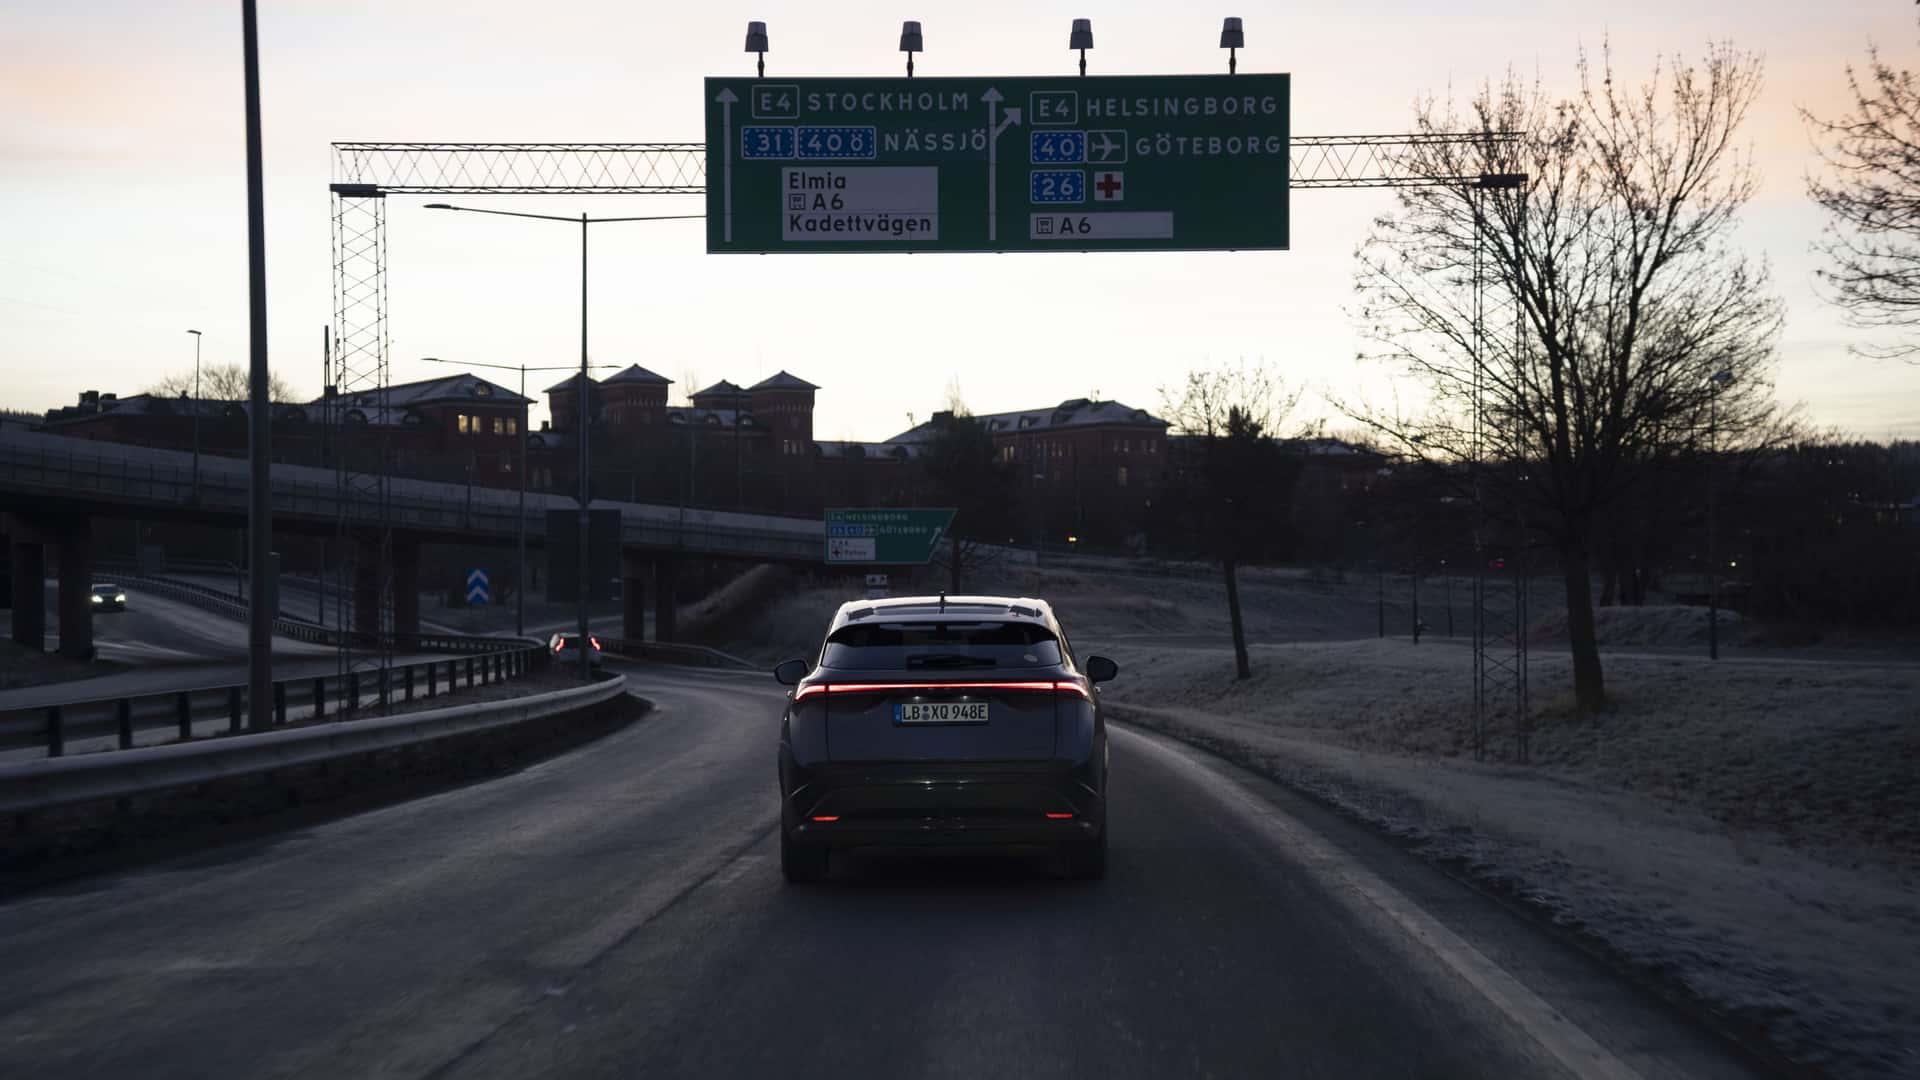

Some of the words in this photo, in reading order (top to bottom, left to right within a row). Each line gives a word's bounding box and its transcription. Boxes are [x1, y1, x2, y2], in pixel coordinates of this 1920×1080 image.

[760, 93, 791, 111] E4
[808, 93, 968, 111] STOCKHOLM
[1039, 99, 1070, 117] E4
[1086, 96, 1277, 117] HELSINGBORG
[757, 134, 782, 150] 31
[885, 129, 986, 150] NÄSSJÖ
[1041, 139, 1075, 156] 40
[1136, 133, 1281, 155] GÖTEBORG
[789, 172, 847, 190] Elmia
[1042, 178, 1074, 196] 26
[812, 193, 844, 211] A6
[789, 214, 931, 235] Kadettvägen
[1060, 217, 1091, 234] A6
